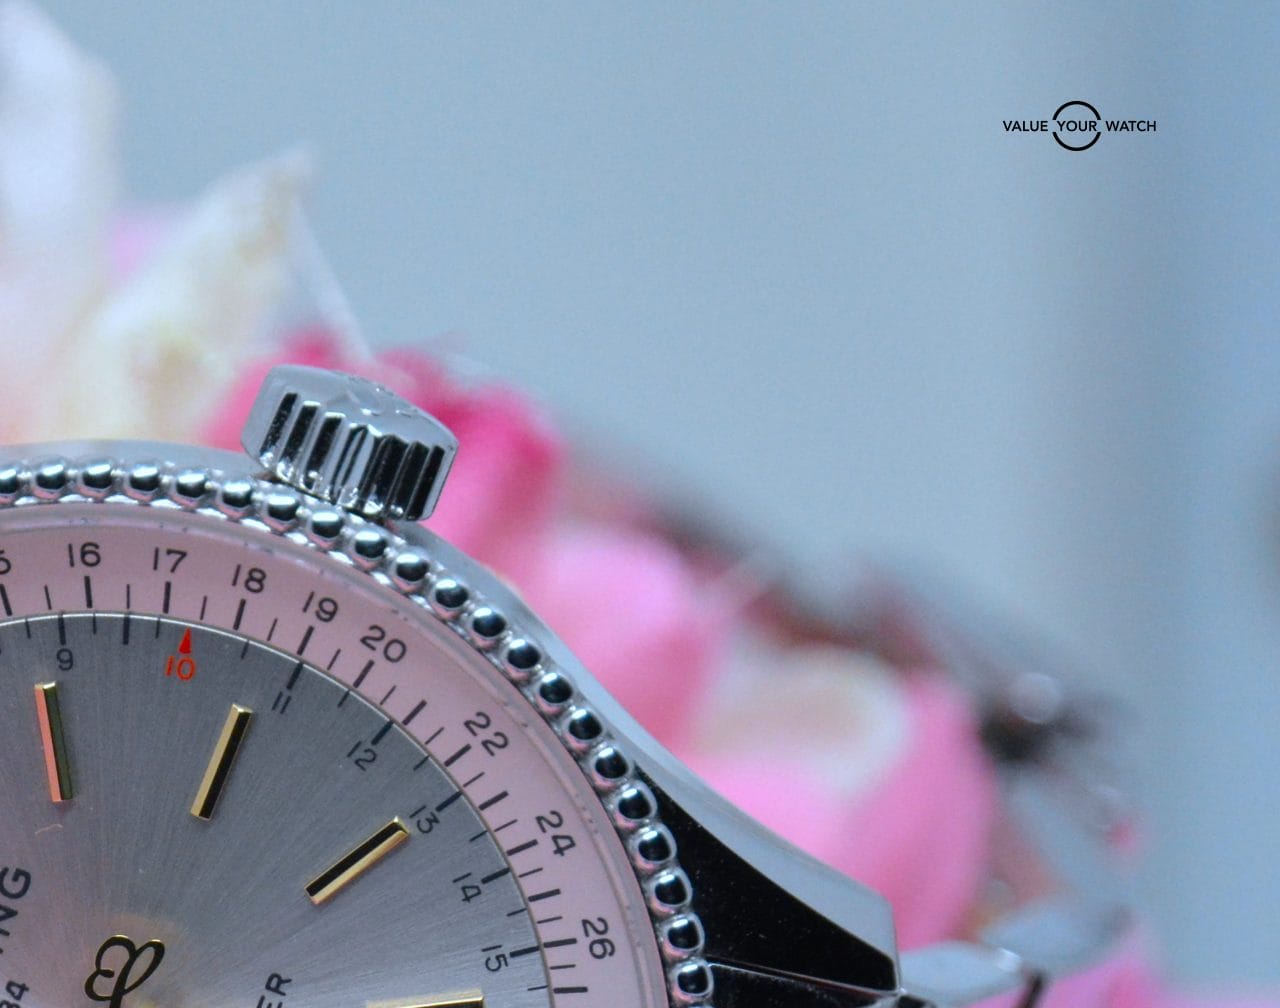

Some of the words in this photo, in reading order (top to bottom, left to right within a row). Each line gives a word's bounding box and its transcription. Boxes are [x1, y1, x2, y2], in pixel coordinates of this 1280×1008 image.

[68, 542, 101, 567] 16
[153, 547, 187, 573] 17
[231, 564, 267, 593] 18
[303, 591, 338, 622] 19
[360, 625, 407, 663] 20
[56, 649, 73, 671] 9
[166, 656, 196, 680] 10
[272, 692, 292, 714] 11
[464, 711, 509, 757] 22
[347, 741, 377, 771] 12
[409, 805, 439, 834] 13
[535, 810, 576, 856] 24
[452, 872, 481, 902] 14
[582, 917, 615, 960] 26
[481, 945, 508, 972] 15
